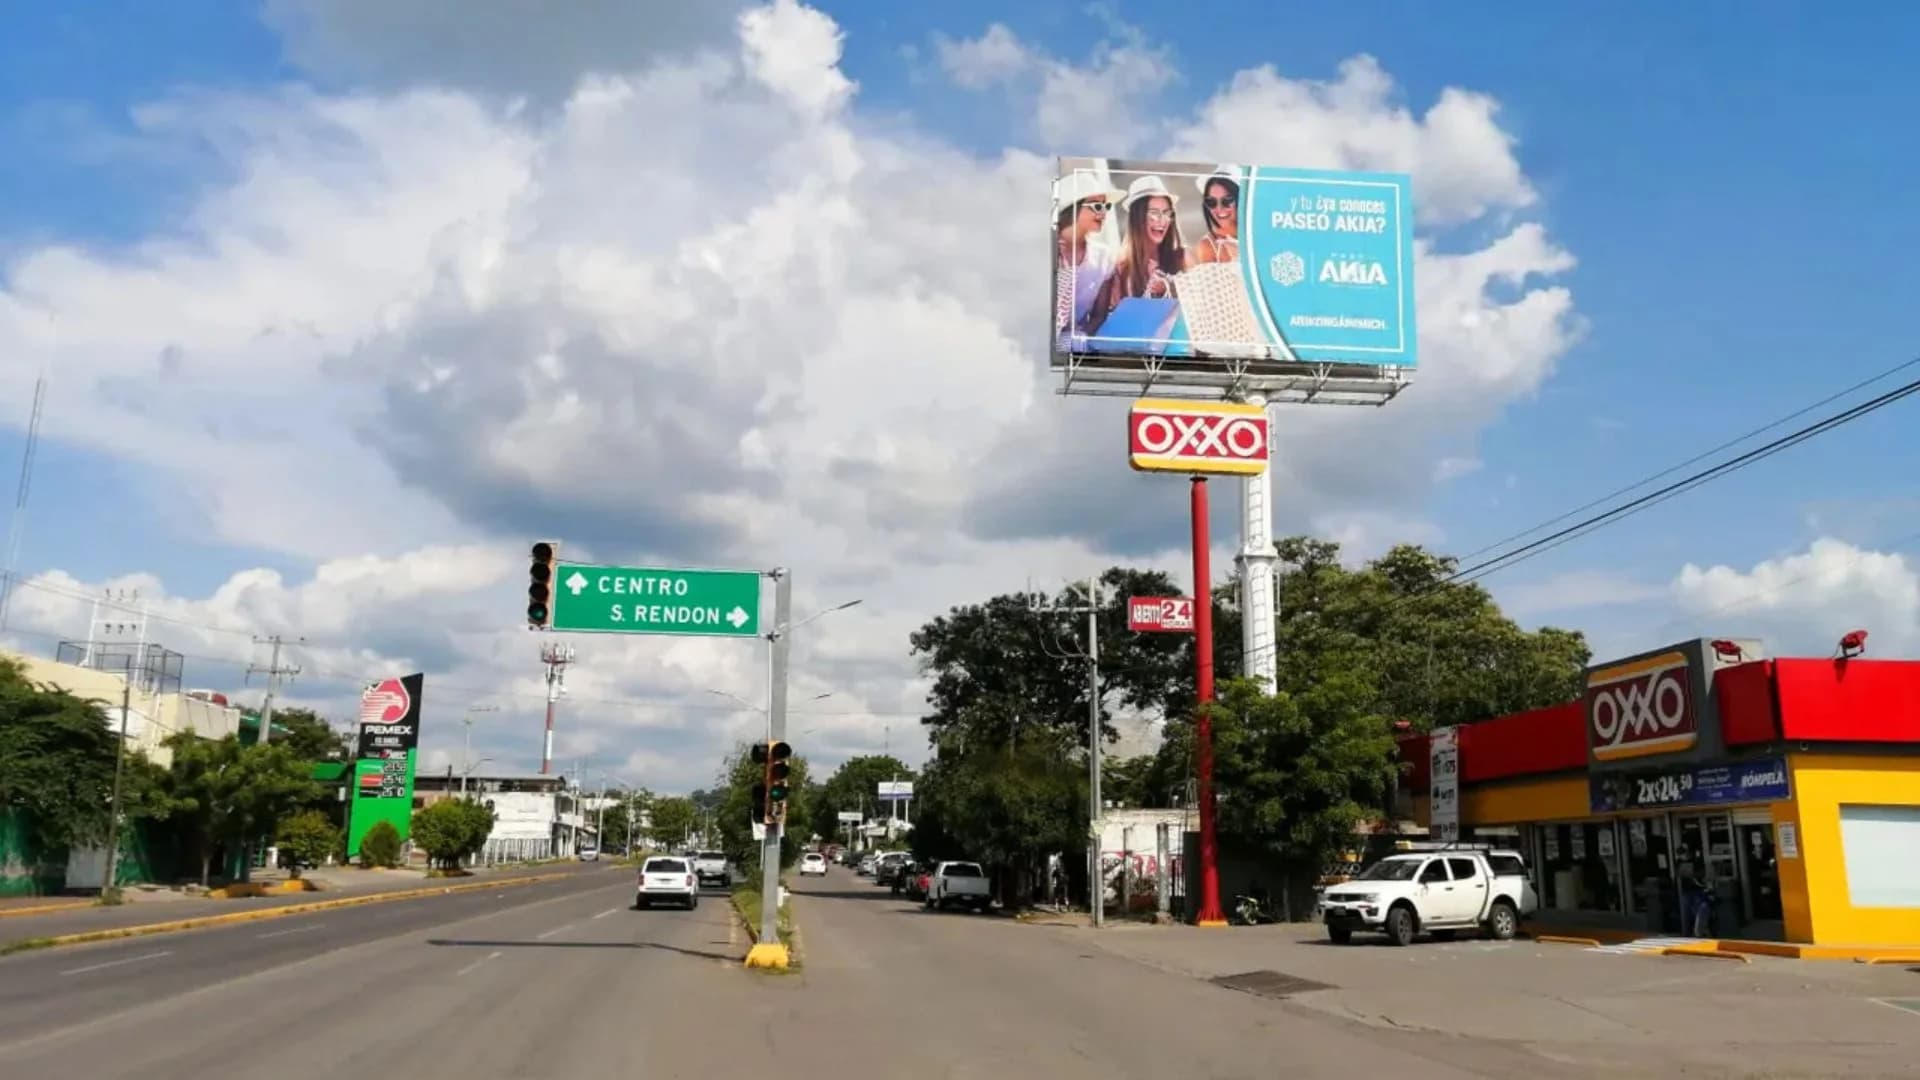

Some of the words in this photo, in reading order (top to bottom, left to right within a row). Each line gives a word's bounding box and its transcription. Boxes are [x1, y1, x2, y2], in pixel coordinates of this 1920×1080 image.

[1271, 211, 1330, 231] PASEO
[1335, 214, 1386, 234] AKIA?
[1138, 414, 1262, 460] OXXO
[598, 576, 688, 596] CENTRO
[610, 604, 626, 622] S.
[635, 605, 720, 624] RENDON
[1162, 601, 1191, 620] 24
[1593, 674, 1685, 748] OXXO
[365, 725, 412, 735] PEMEX
